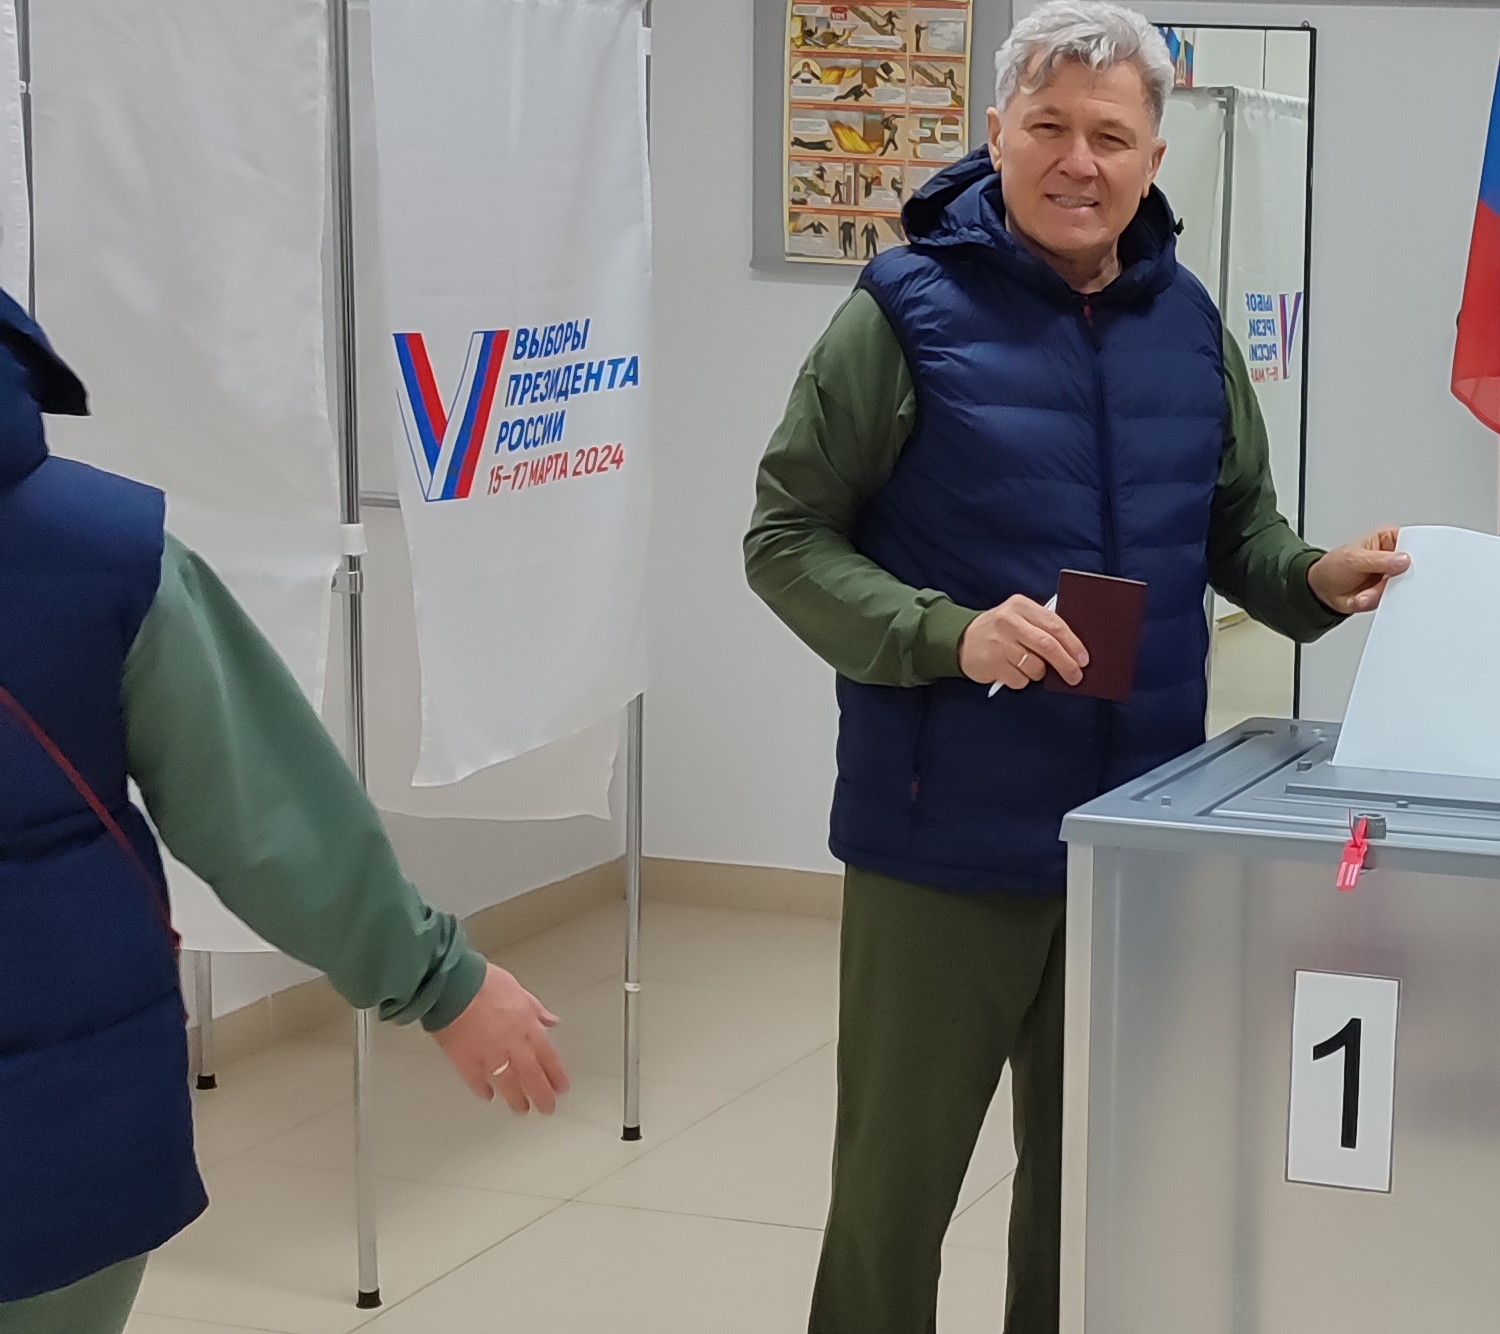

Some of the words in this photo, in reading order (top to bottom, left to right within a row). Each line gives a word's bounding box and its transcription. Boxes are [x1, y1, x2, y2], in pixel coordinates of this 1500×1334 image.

[512, 318, 591, 361] ВЫБОРЫ
[505, 355, 640, 408] ПРЕЗИДЕНТА
[495, 410, 567, 454] РОССИИ
[528, 451, 569, 488] МАРТА
[571, 443, 625, 479] 2024
[1312, 1017, 1362, 1149] 1
